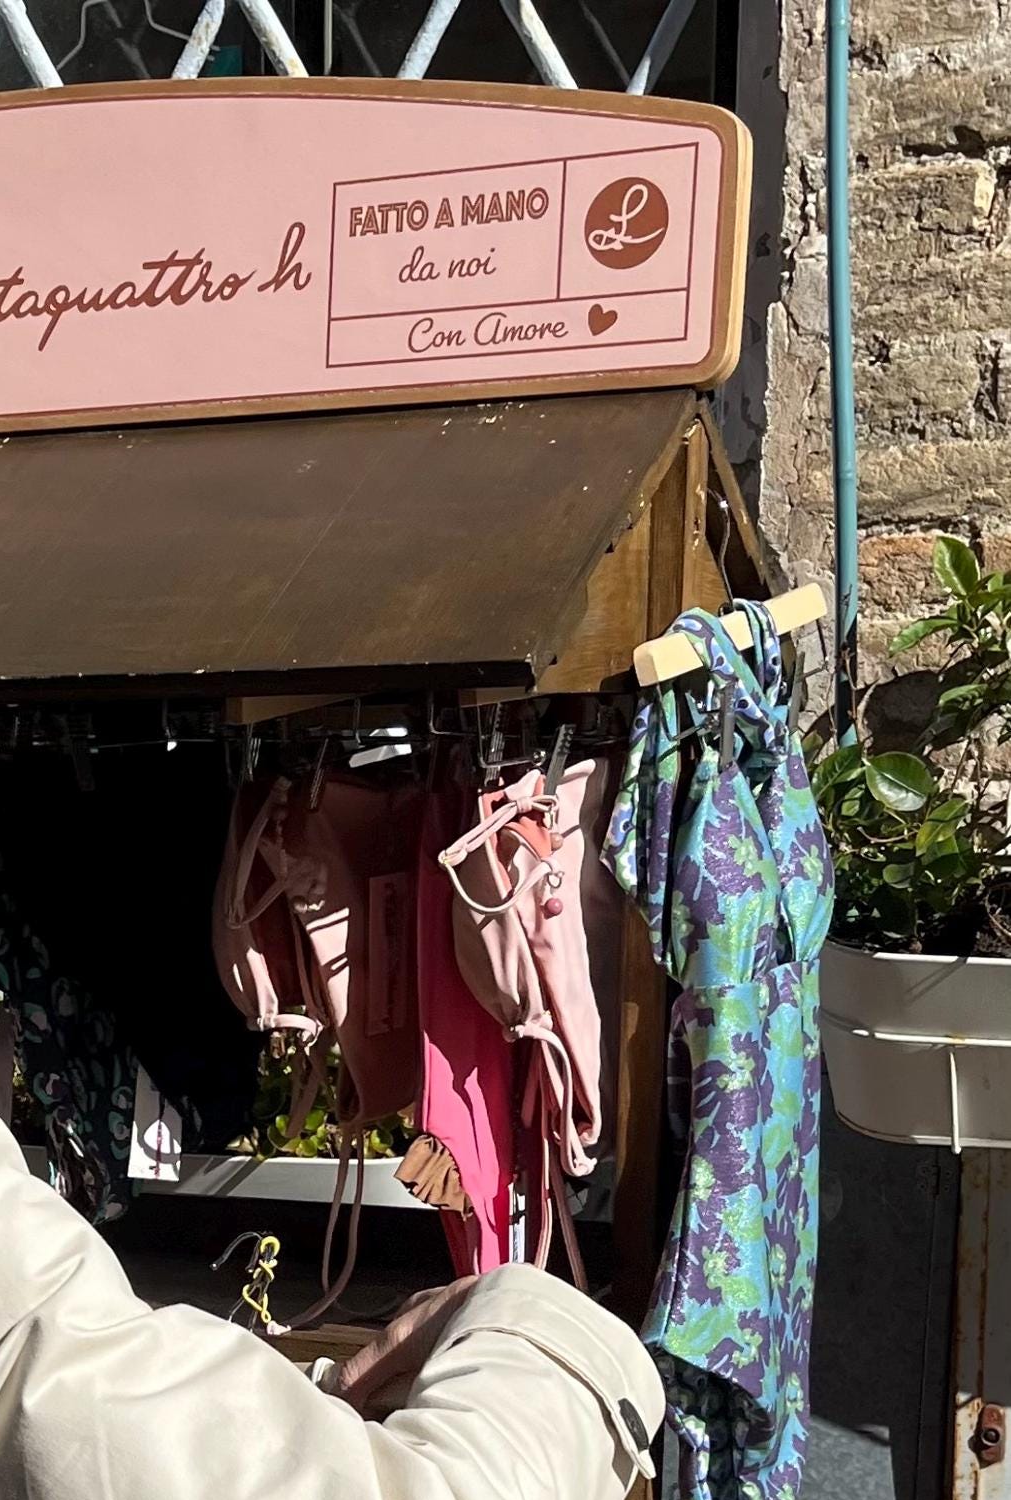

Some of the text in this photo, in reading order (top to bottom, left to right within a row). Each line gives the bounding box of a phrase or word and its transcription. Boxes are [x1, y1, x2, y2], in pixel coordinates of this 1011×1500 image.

[348, 186, 550, 238] FATTO A MANO
[398, 245, 497, 284] da noi
[407, 311, 570, 354] Con Amore
